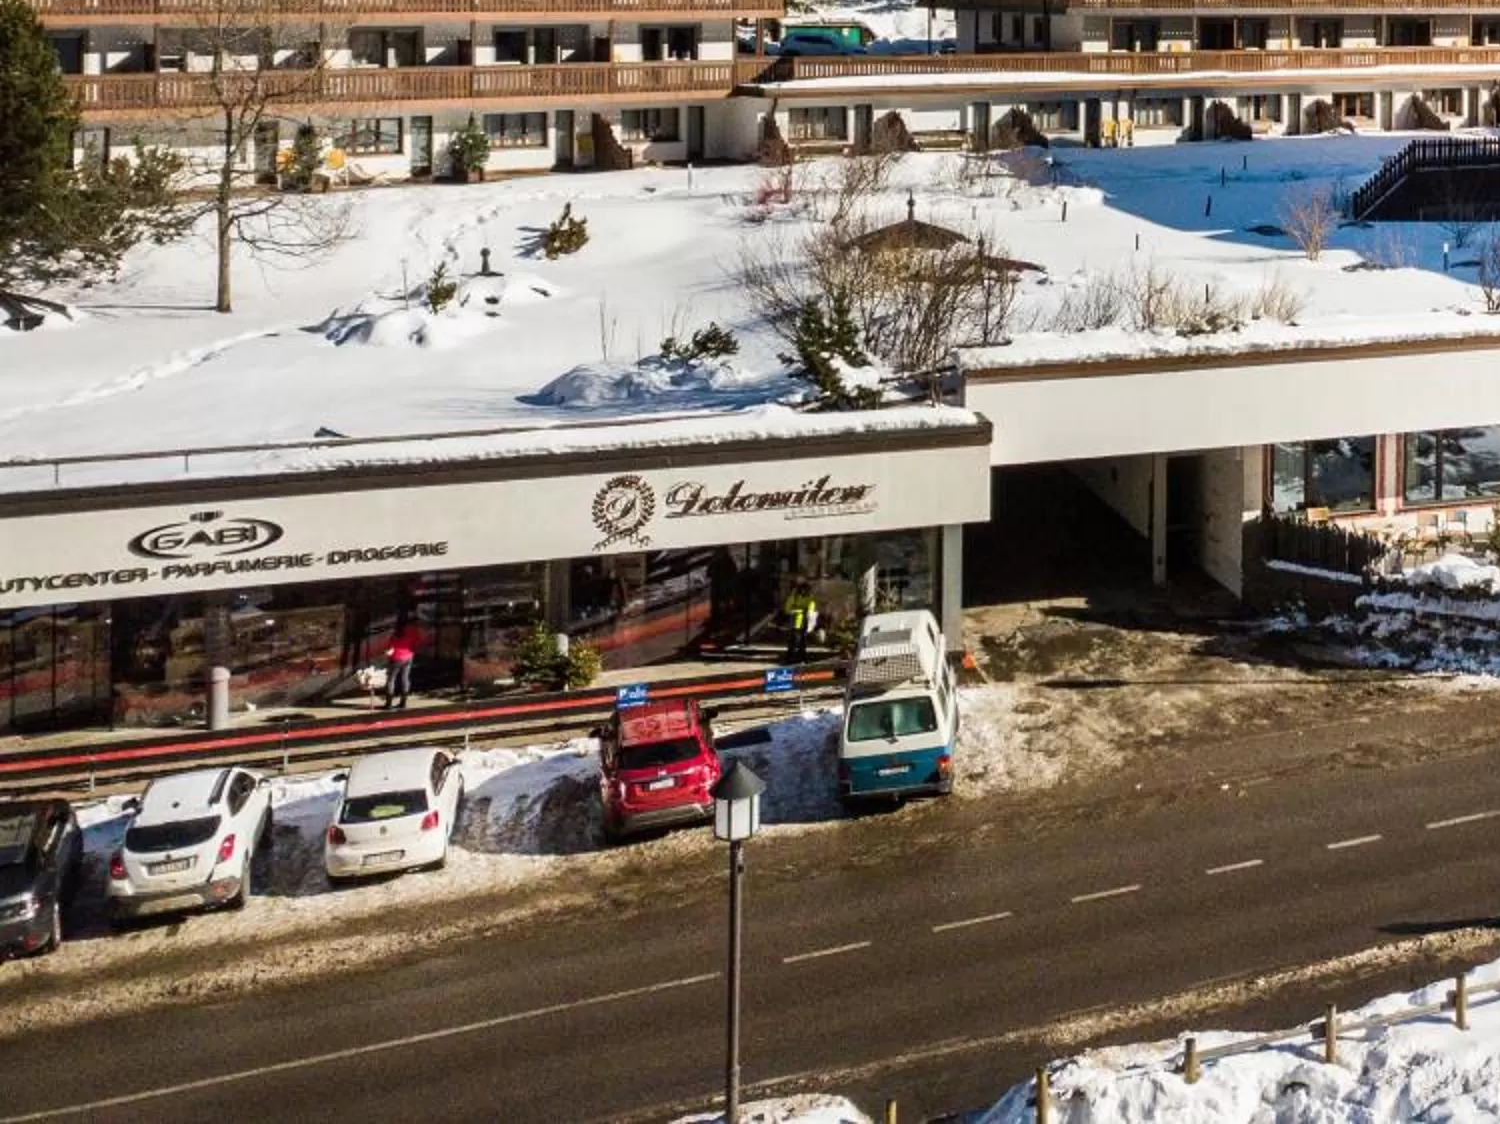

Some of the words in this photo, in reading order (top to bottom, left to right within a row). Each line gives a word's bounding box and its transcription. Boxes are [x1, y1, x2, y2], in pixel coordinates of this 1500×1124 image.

[150, 525, 257, 551] GABI
[161, 552, 313, 579] PARFUMERIE
[327, 540, 449, 565] DROGERIE
